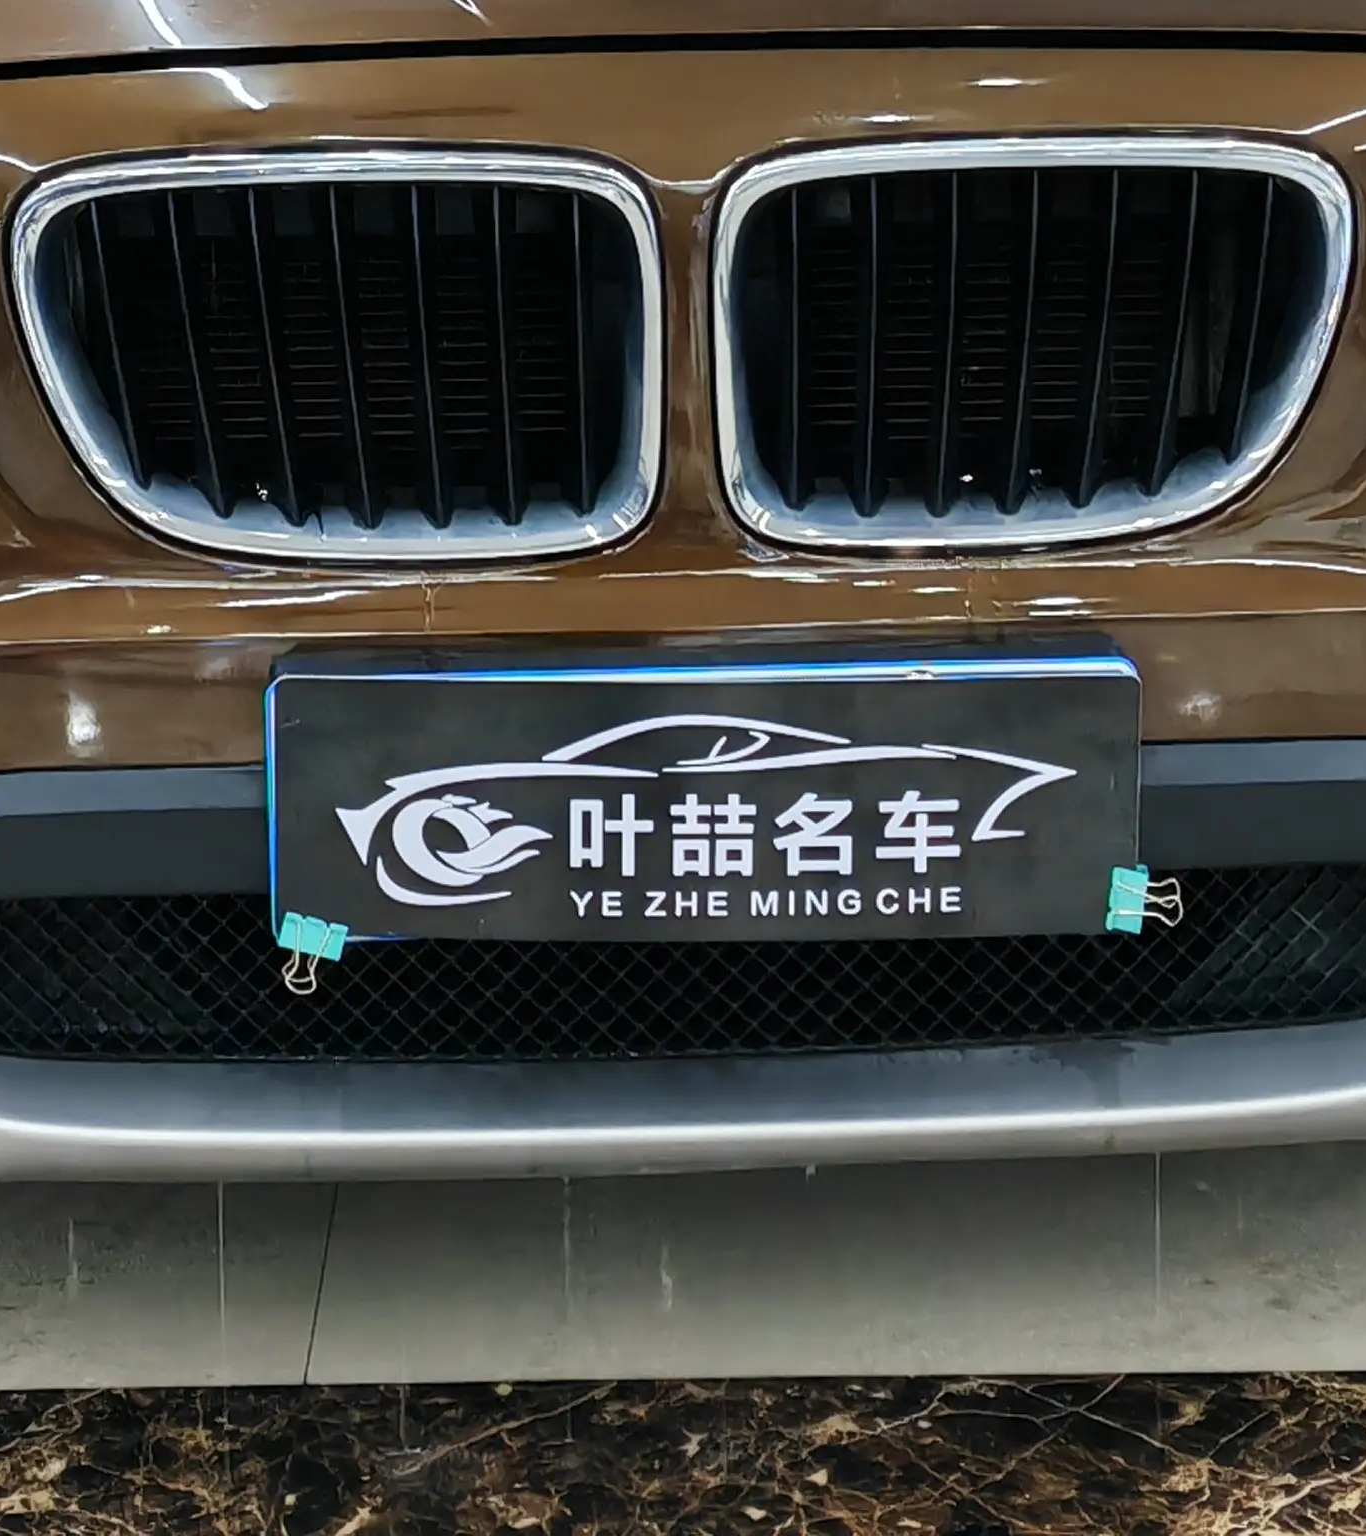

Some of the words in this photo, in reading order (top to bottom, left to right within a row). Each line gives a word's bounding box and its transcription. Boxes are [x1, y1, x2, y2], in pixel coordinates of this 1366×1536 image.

[568, 789, 963, 878] 叶喆名车
[568, 889, 624, 919] YE
[643, 889, 729, 918] ZHE
[749, 888, 863, 917] MING
[875, 885, 963, 916] CHE
